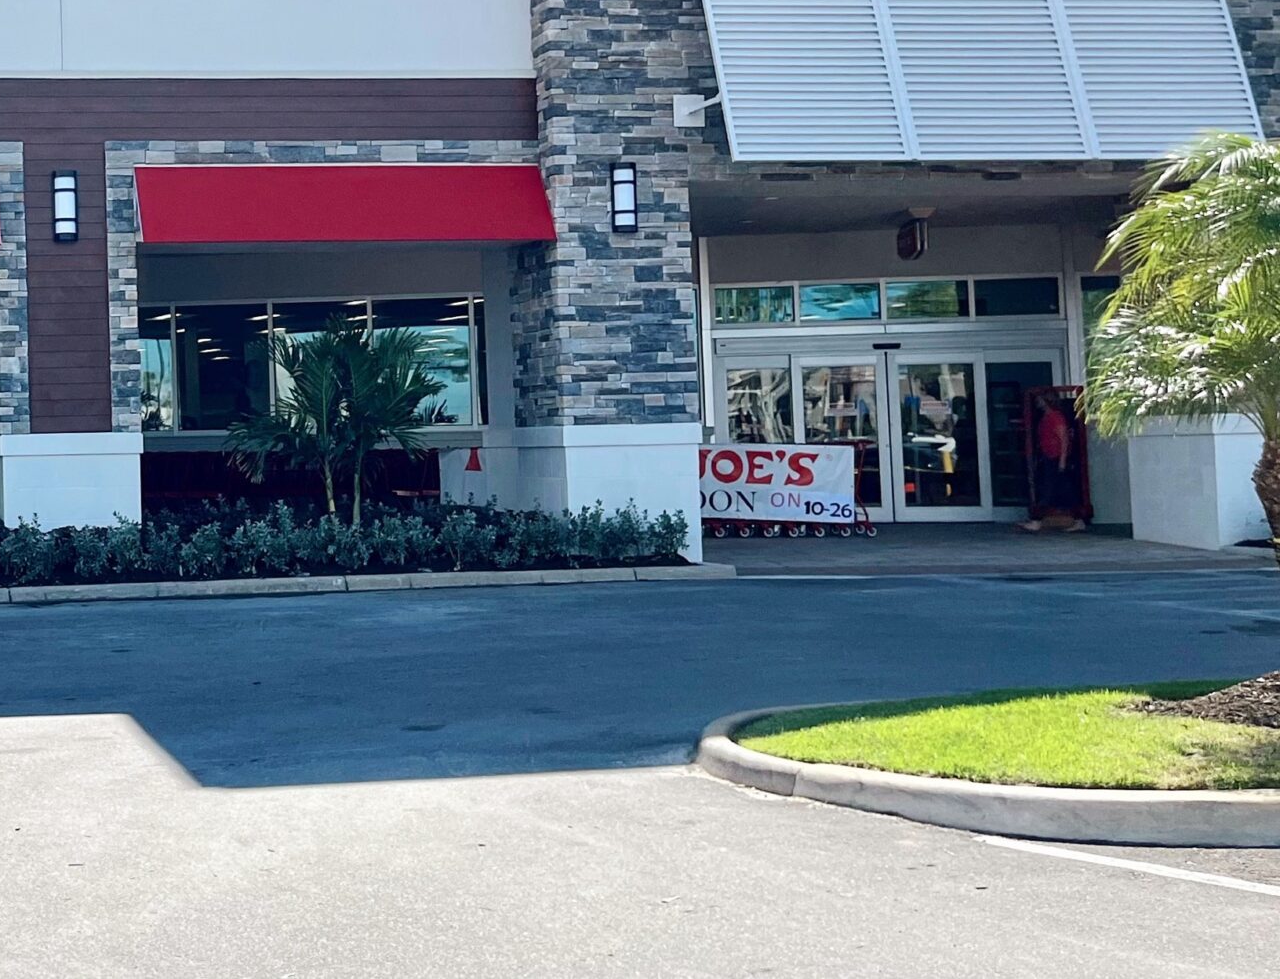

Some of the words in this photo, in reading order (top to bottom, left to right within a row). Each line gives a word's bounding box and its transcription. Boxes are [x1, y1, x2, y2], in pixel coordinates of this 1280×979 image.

[699, 489, 756, 513] ON
[770, 492, 801, 508] ON
[804, 501, 852, 518] 10-26
